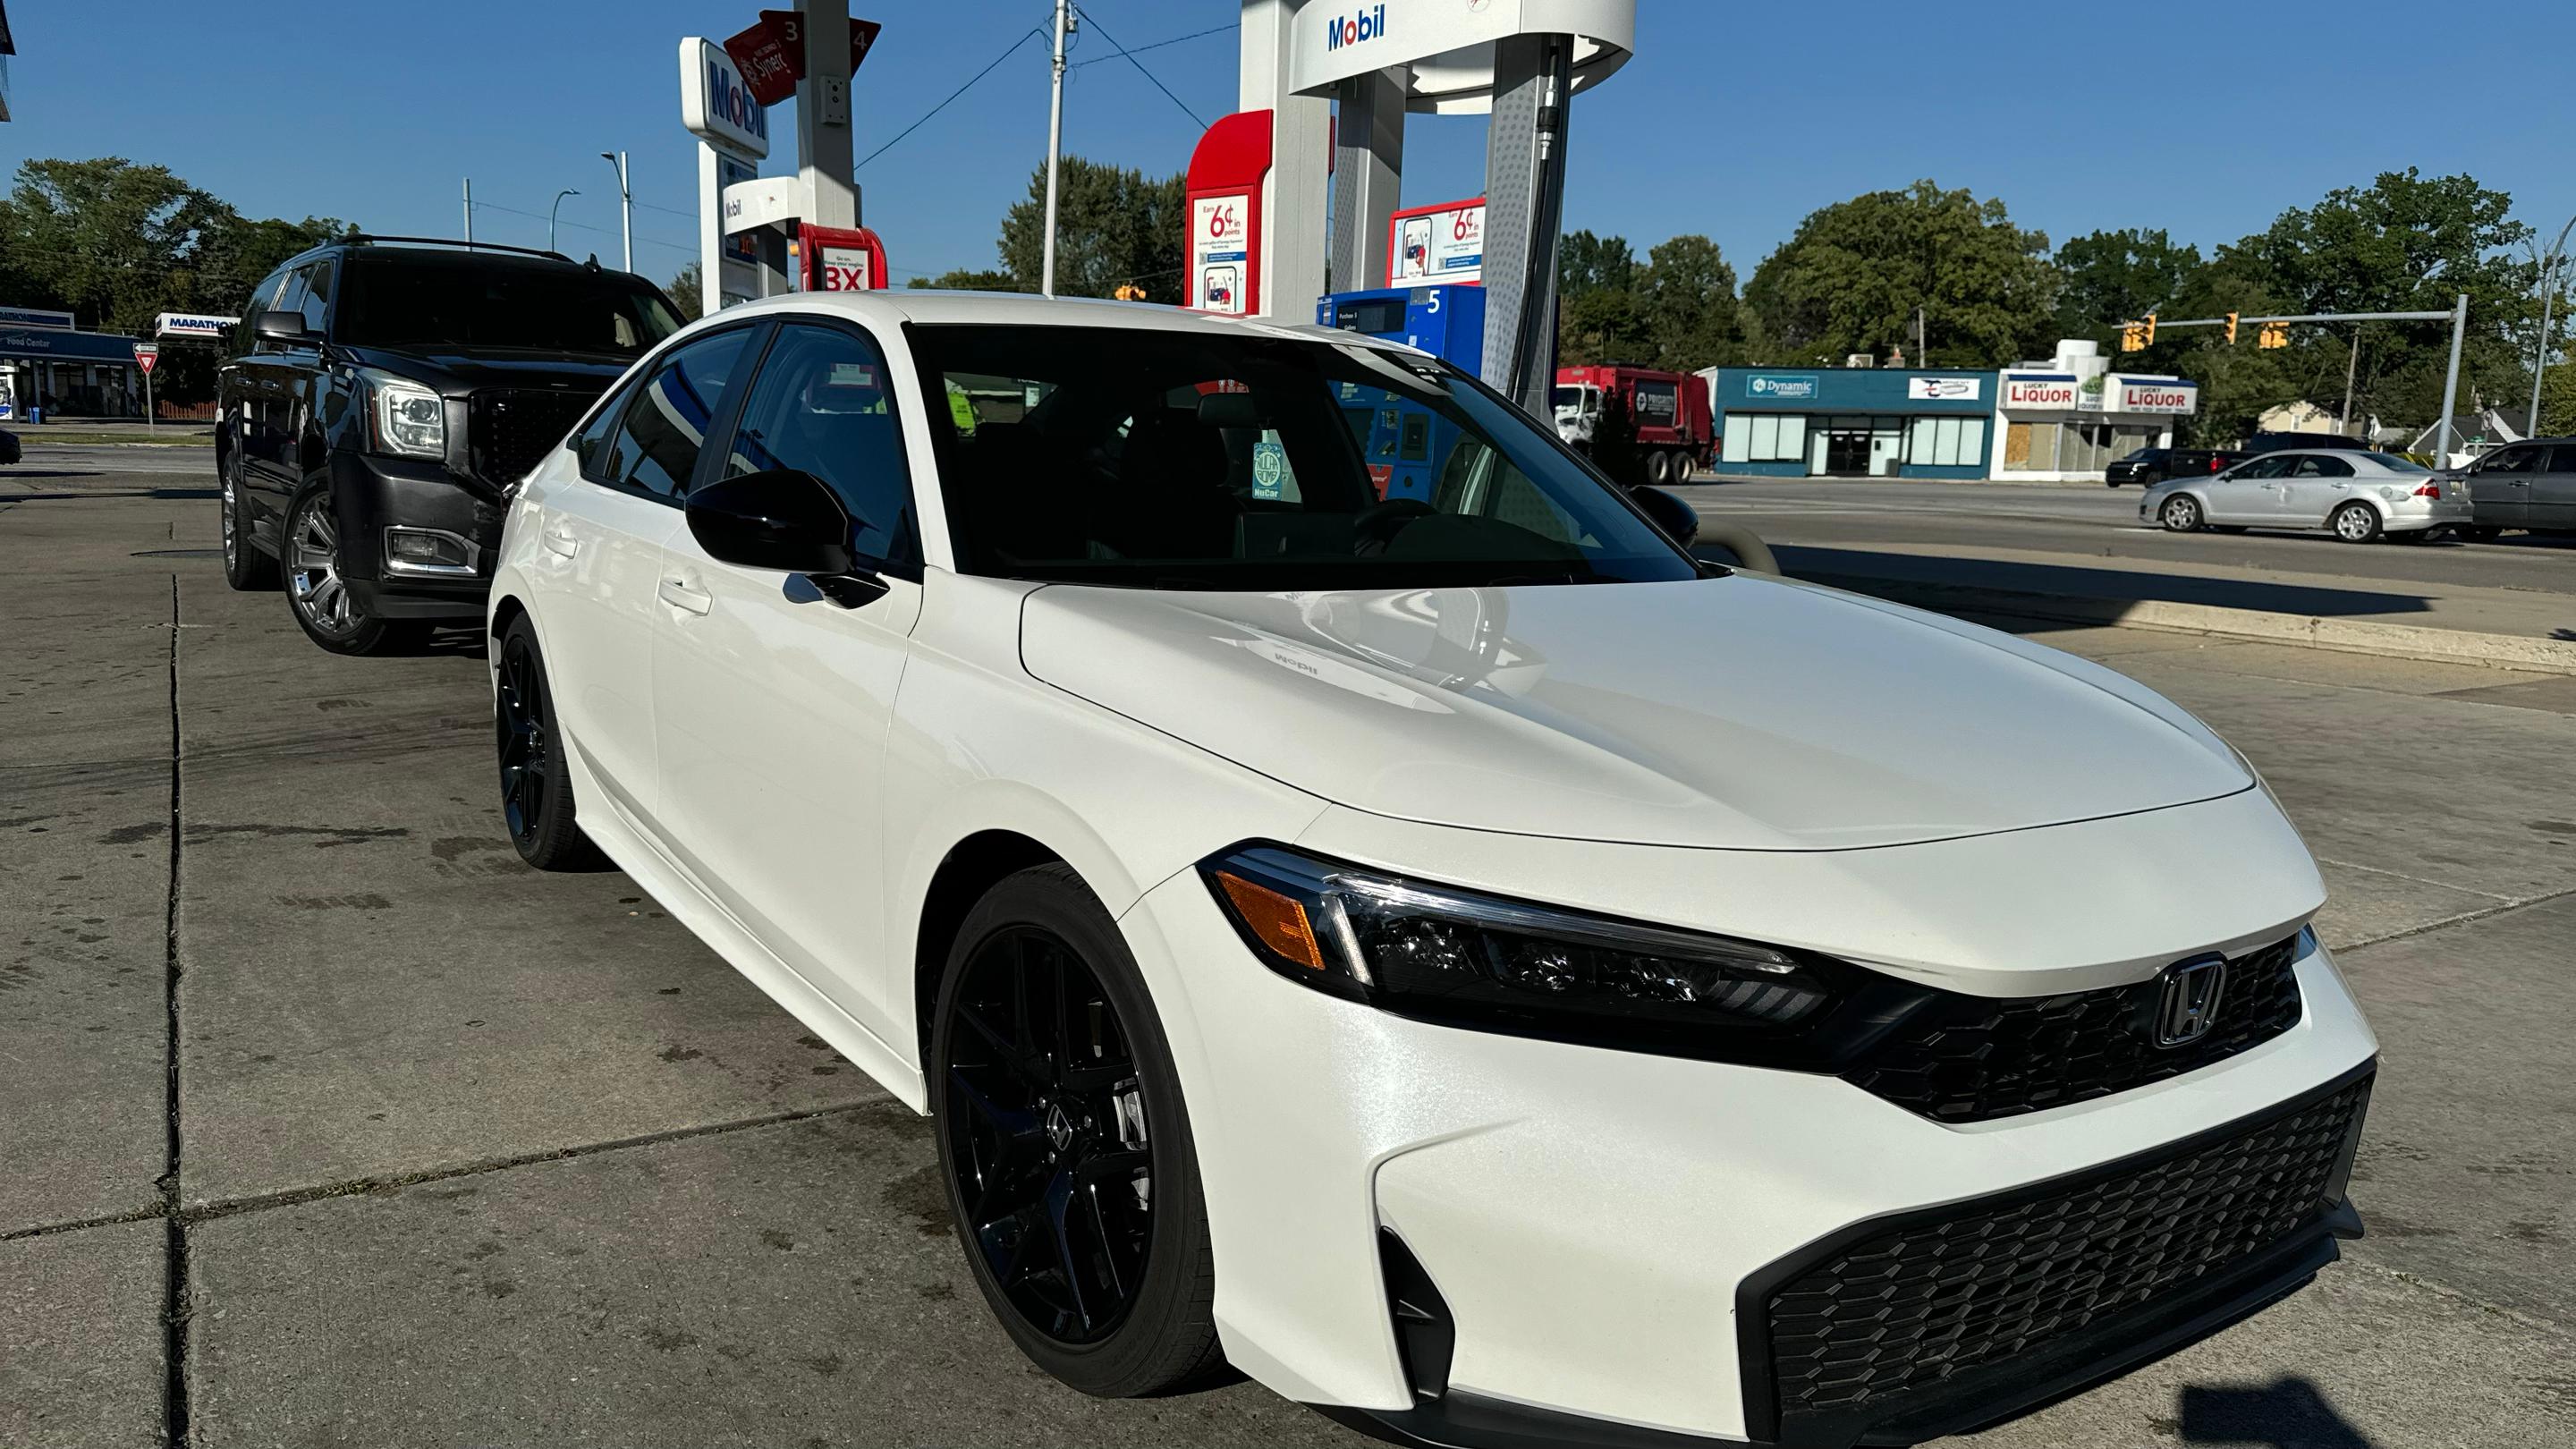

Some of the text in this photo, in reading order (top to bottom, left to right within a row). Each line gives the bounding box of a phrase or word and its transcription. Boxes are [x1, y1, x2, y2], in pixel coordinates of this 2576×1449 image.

[784, 21, 799, 41] 3
[1328, 4, 1385, 52] Mobil
[853, 30, 867, 50] 4
[709, 60, 767, 140] Mobil
[725, 199, 742, 219] Mobil
[1224, 228, 1241, 237] points
[825, 267, 864, 292] 3X
[1428, 289, 1441, 314] 5
[6, 336, 51, 348] Food Center
[1767, 379, 1813, 394] Dynamic
[1254, 487, 1279, 498] NuCar
